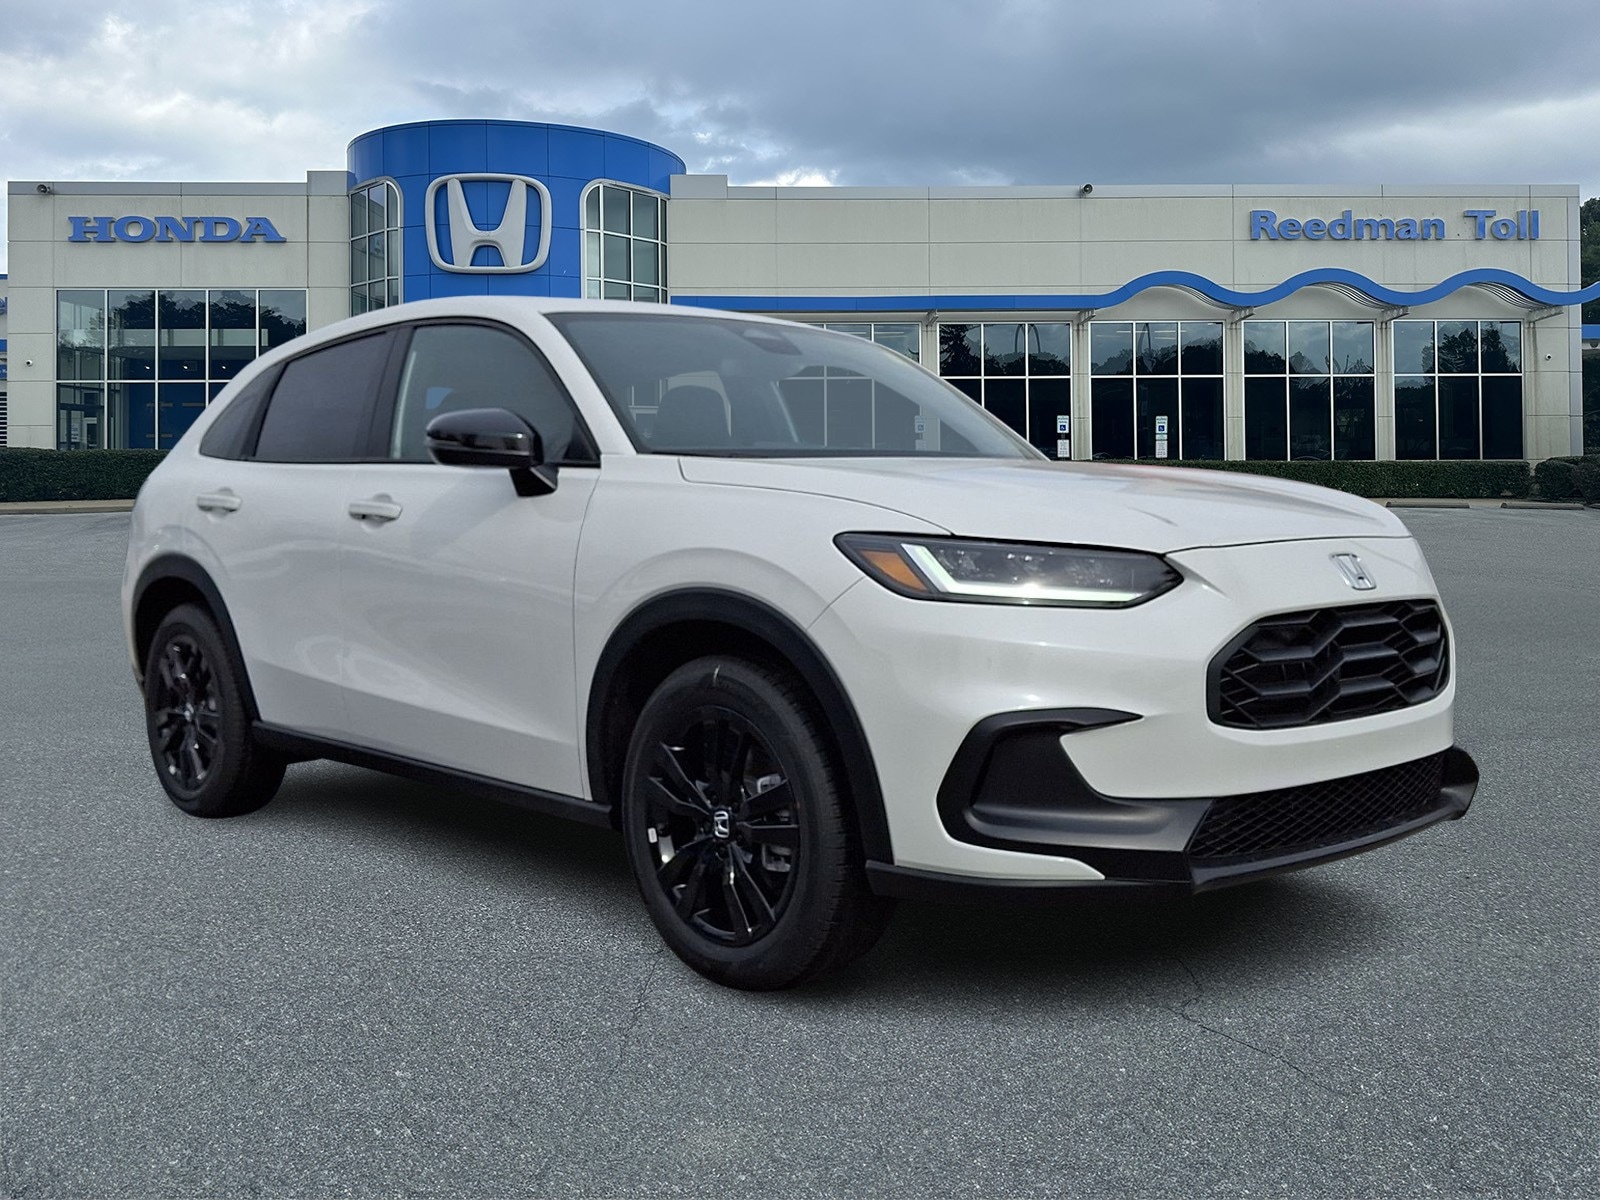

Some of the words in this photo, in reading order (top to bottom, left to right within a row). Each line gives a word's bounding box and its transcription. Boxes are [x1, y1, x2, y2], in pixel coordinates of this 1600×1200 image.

[67, 215, 287, 243] HONDA
[1250, 209, 1446, 241] Reedman
[1463, 209, 1540, 241] Toll
